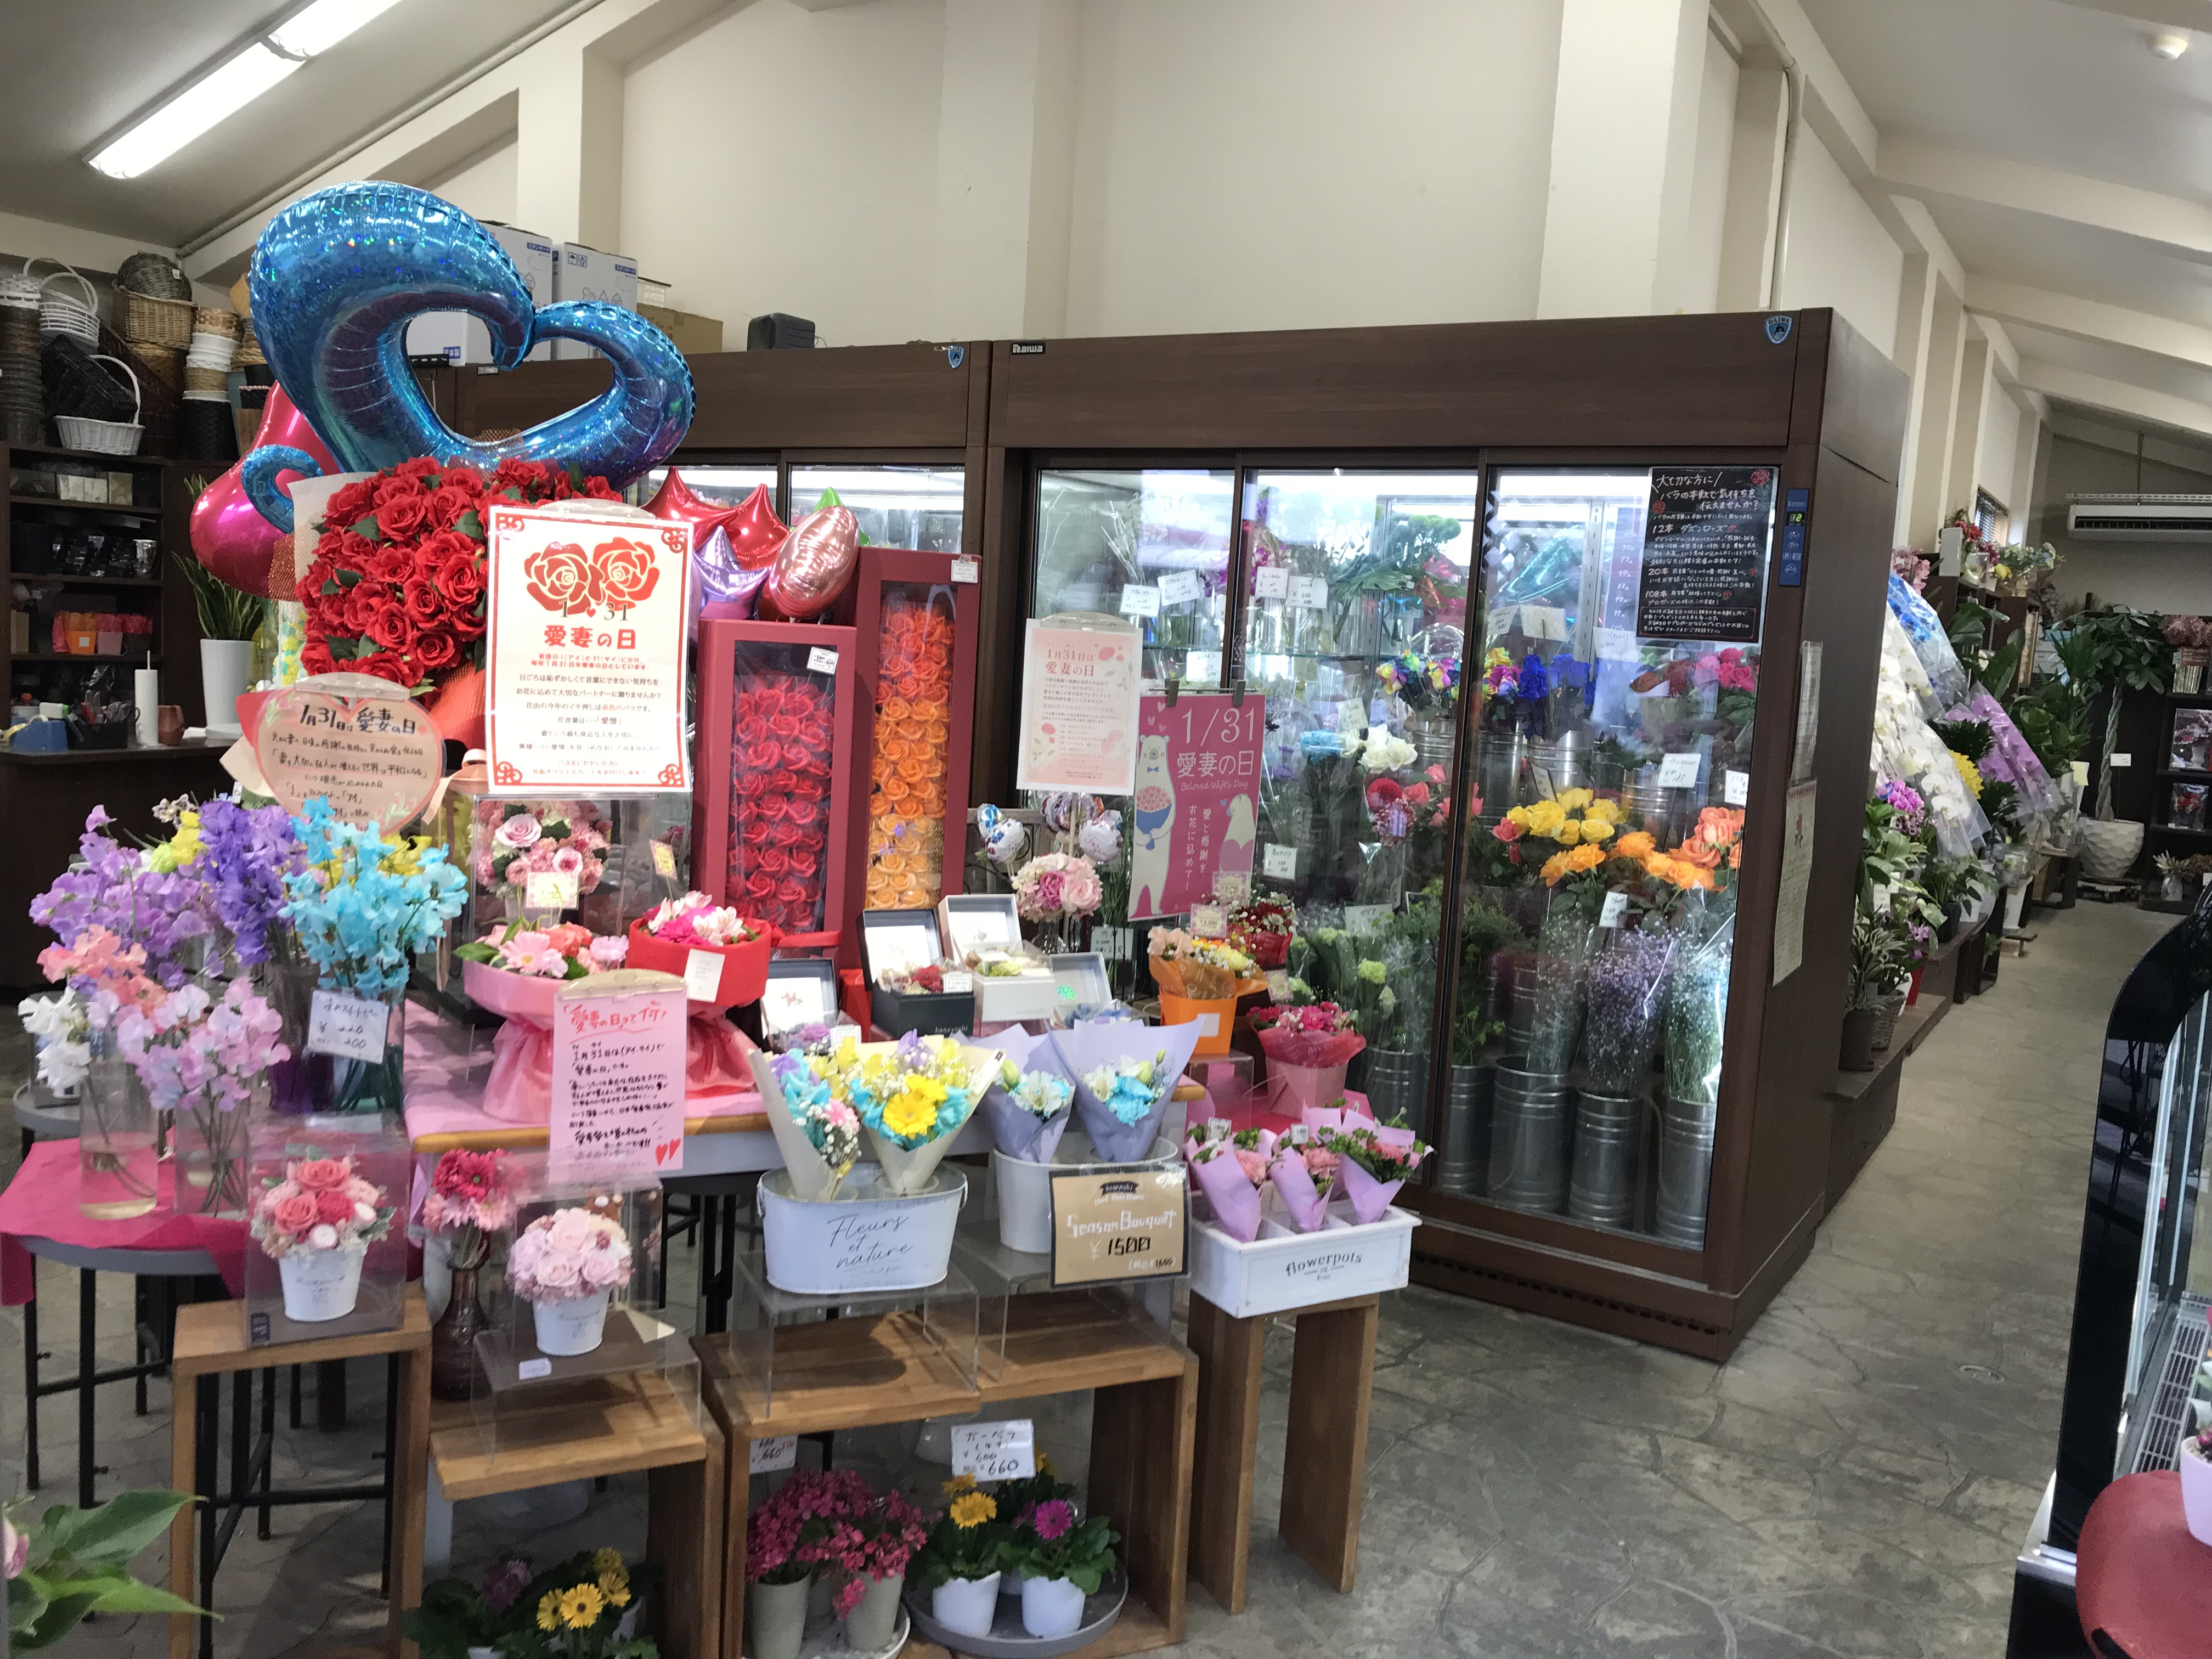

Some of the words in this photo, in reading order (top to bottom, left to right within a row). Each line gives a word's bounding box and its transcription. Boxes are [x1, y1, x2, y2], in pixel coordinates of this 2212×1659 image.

[1660, 488, 1756, 500] バラの本数で気持ちを
[1652, 523, 1673, 534] 12本
[1680, 523, 1728, 533] ダズンローズ
[558, 600, 569, 618] 1
[603, 602, 629, 621] 31
[544, 625, 636, 650] 愛妻の日
[1048, 648, 1094, 662] 1月31日は
[1046, 661, 1094, 676] 愛妻の日
[520, 674, 659, 686] 日ごろは恥ずかしくて言葉にできない気持ちを
[1182, 707, 1256, 747] 1/31
[1177, 751, 1255, 778] 愛妻の日
[1181, 781, 1211, 791] Beloved
[1211, 780, 1232, 792] Wife's
[1234, 780, 1248, 789] Day
[1120, 1209, 1177, 1231] Bouquet
[827, 1212, 910, 1248] Fleurs
[836, 1242, 913, 1269] nature
[1285, 1251, 1363, 1277] flowerpots
[975, 1452, 997, 1463] 600
[988, 1458, 1019, 1476] 660
